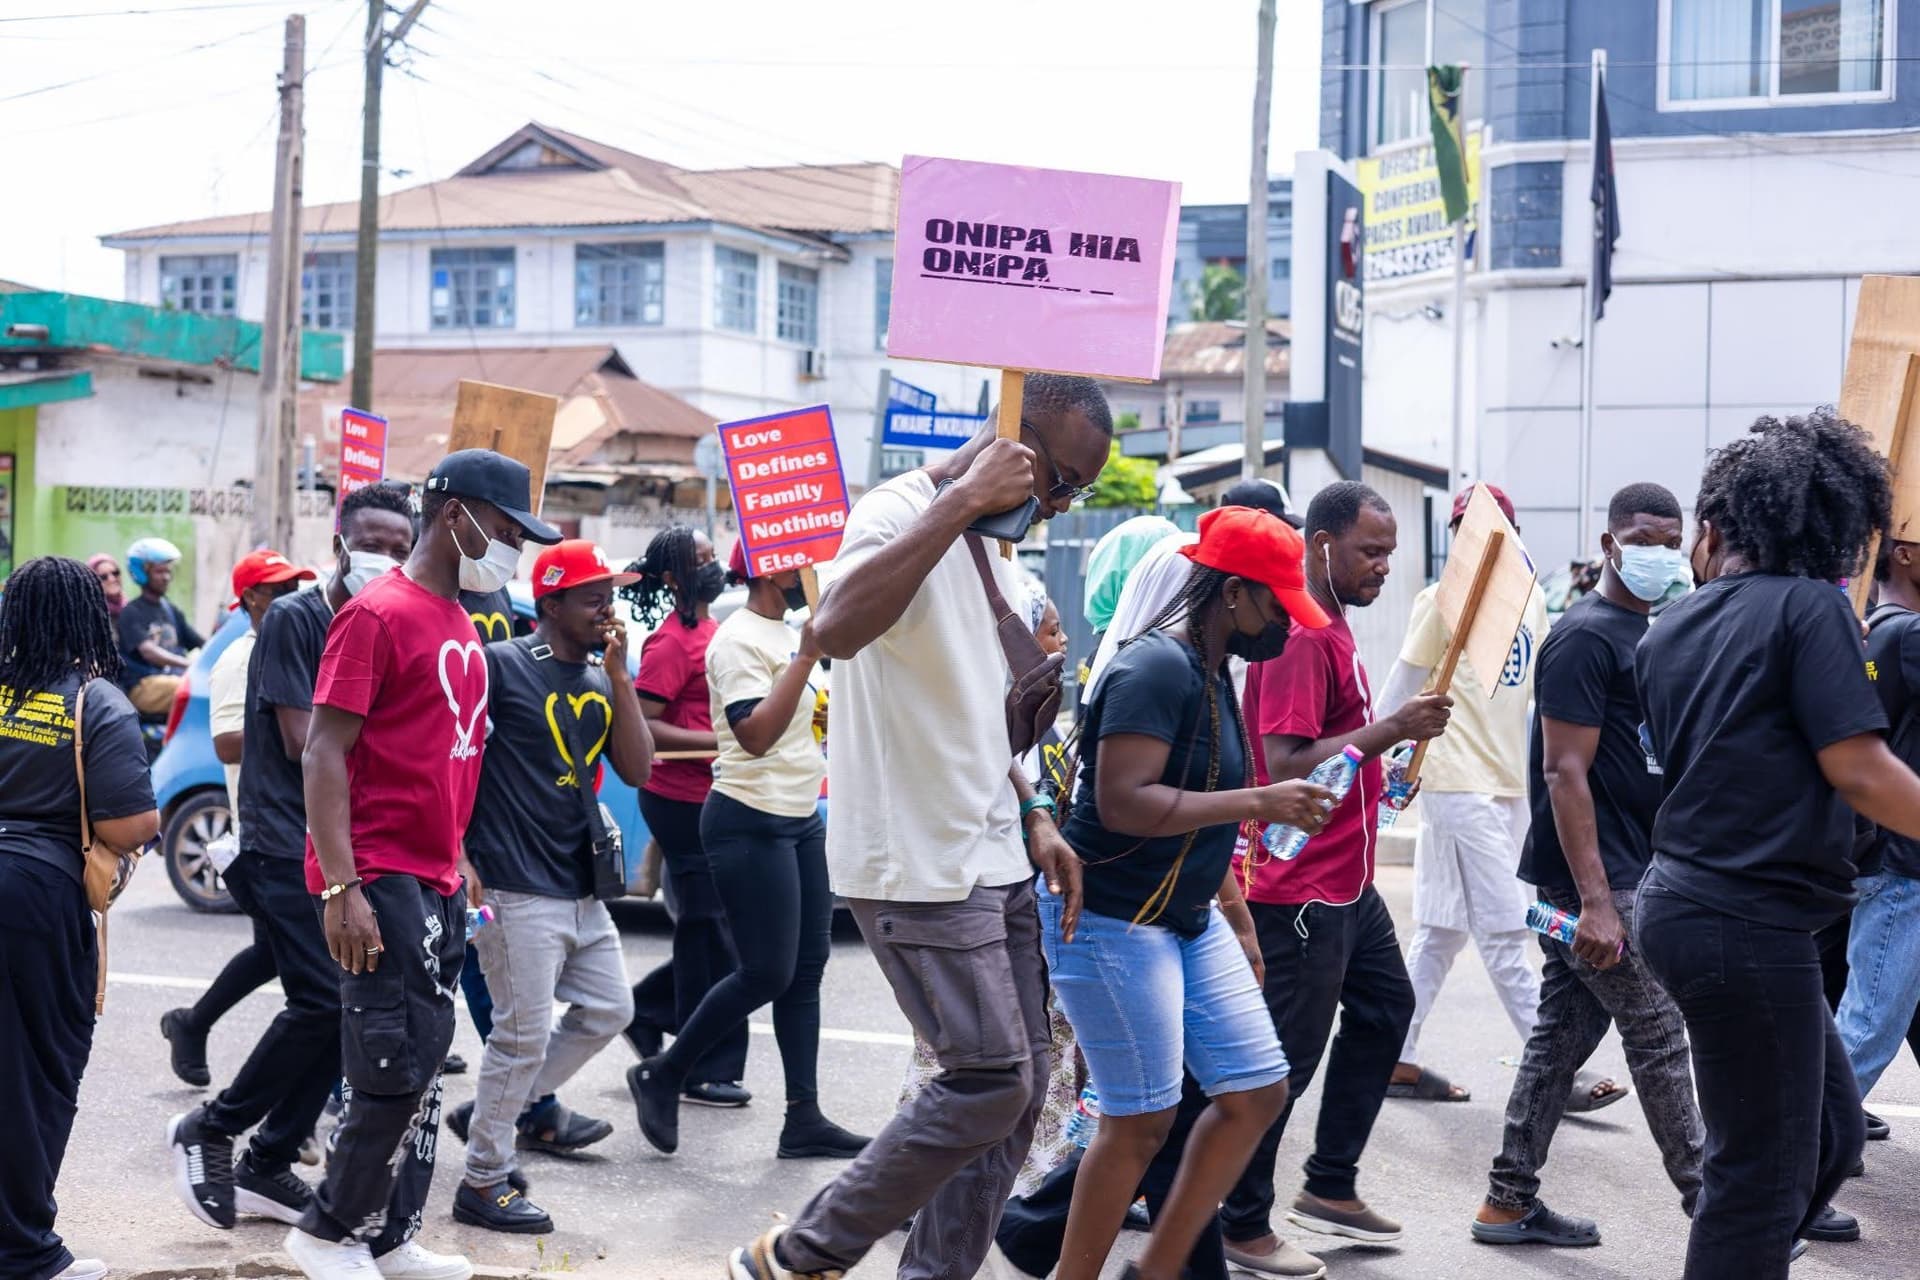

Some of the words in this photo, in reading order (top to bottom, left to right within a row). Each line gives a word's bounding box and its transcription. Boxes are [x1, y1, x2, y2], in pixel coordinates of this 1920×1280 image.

[925, 218, 1053, 254] ONIPA
[1069, 232, 1141, 263] HIA
[922, 247, 1051, 283] ONIPA
[345, 419, 368, 439] Love
[731, 429, 783, 449] Love
[343, 446, 380, 470] Defines
[738, 452, 828, 480] Defines
[744, 483, 824, 511] Family
[751, 509, 845, 540] Nothing
[757, 551, 814, 574] Else.
